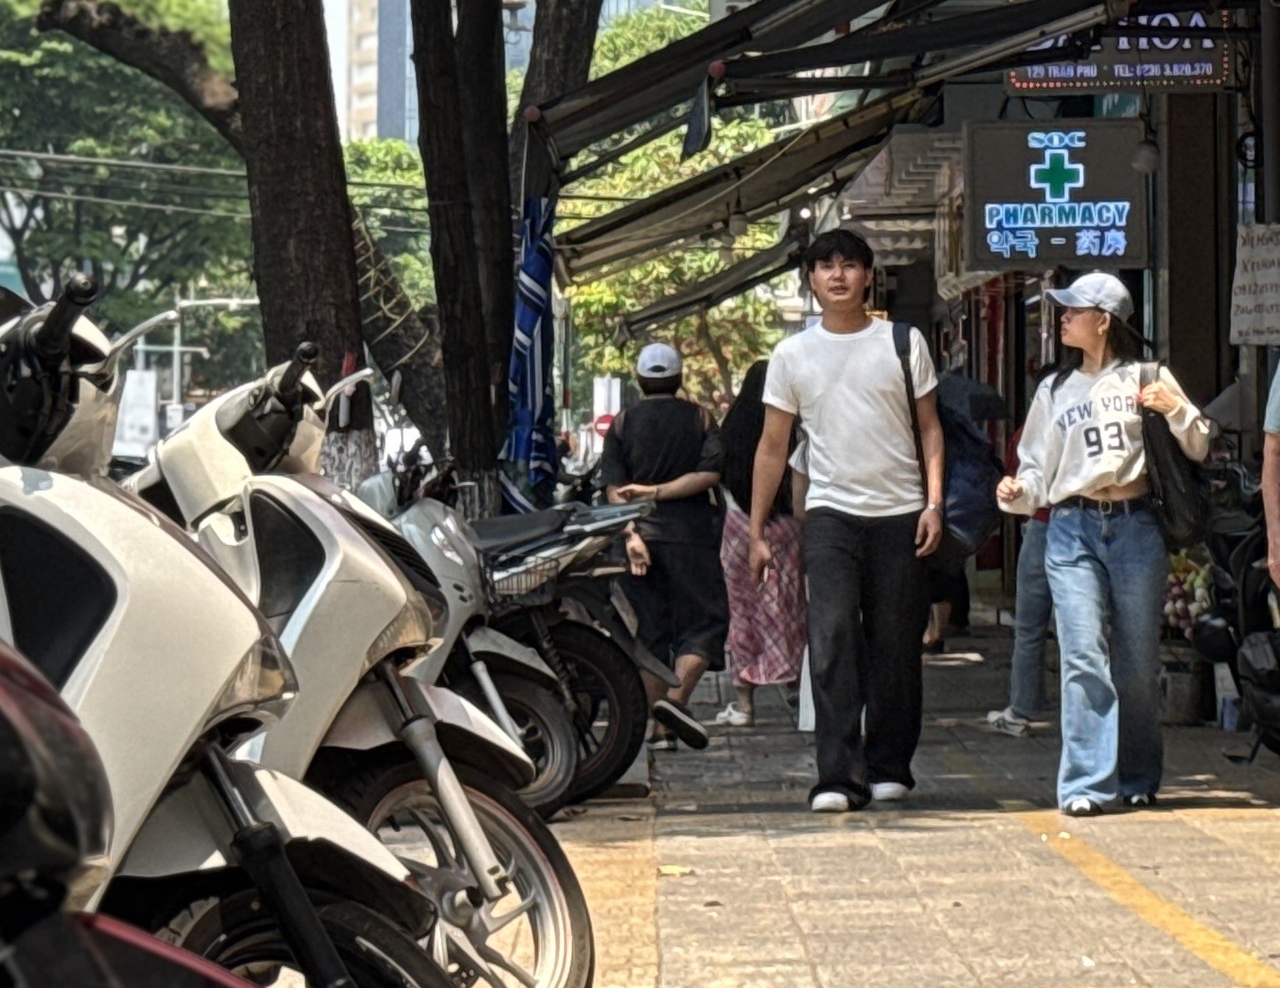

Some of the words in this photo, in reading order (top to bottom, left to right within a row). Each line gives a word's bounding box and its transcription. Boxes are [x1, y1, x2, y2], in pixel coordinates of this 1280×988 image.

[1027, 65, 1045, 78] 129
[985, 202, 1130, 229] PHARMACY
[987, 230, 1039, 258] 약국
[1056, 400, 1093, 435] NEW
[1101, 395, 1142, 412] YOR
[1083, 421, 1126, 458] 93
